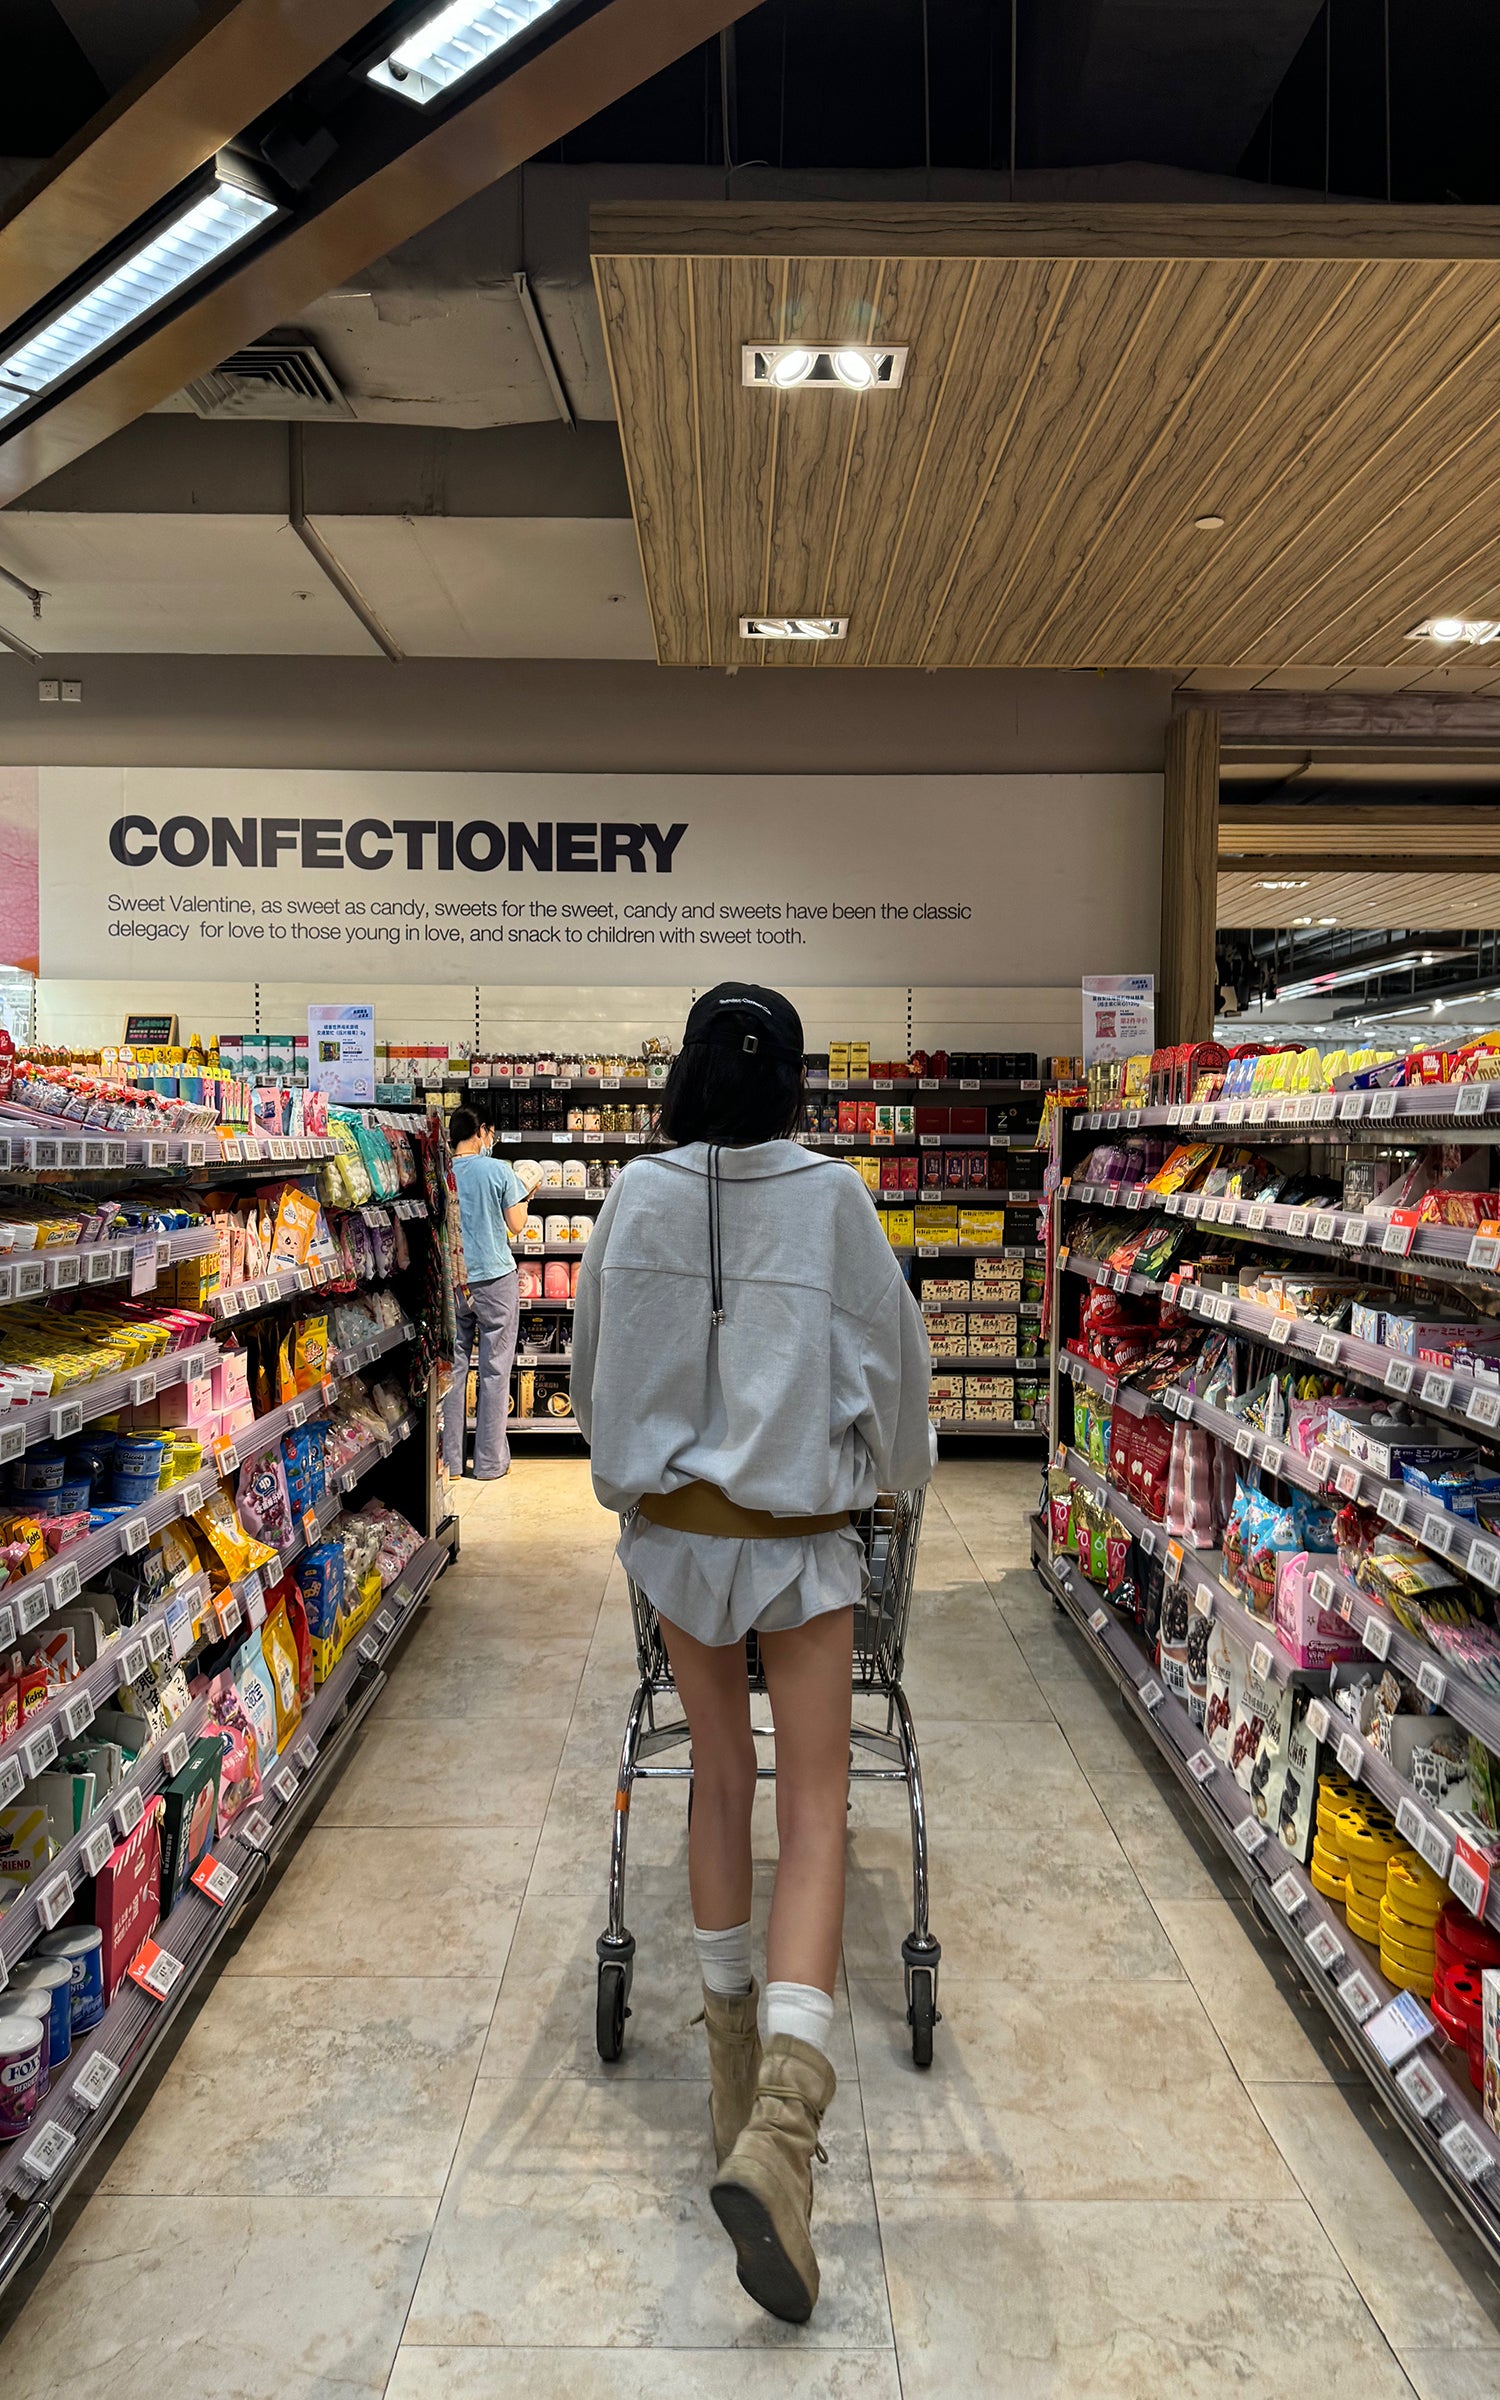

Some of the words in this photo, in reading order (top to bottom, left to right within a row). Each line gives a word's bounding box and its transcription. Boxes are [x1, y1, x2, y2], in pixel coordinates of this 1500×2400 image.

[109, 815, 688, 873] CONFECTIONERY
[108, 894, 165, 911] Sweet
[170, 895, 255, 915] Valentine,
[261, 901, 282, 913] as
[287, 899, 340, 914] sweet
[345, 902, 366, 915] as
[370, 899, 429, 919] candy,
[435, 901, 497, 917] sweets
[501, 900, 525, 917] for
[529, 901, 557, 917] the
[561, 902, 618, 920] sweet,
[624, 902, 677, 922] candy
[682, 902, 714, 919] and
[720, 904, 781, 919] sweets
[786, 903, 827, 919] have
[833, 903, 875, 919] been
[881, 903, 908, 919] the
[913, 903, 971, 919] classic
[108, 920, 189, 941] delegacy
[200, 921, 224, 937] for
[229, 921, 264, 938] love
[268, 923, 286, 939] to
[291, 922, 341, 940] those
[345, 927, 400, 944] young
[406, 924, 419, 940] in
[425, 924, 464, 943] love,
[470, 925, 503, 942] and
[508, 926, 561, 942] snack
[565, 927, 582, 942] to
[587, 926, 654, 943] children
[659, 927, 695, 943] with
[700, 928, 752, 944] sweet
[756, 928, 805, 944] tooth.
[1478, 1061, 1500, 1081] mei
[1348, 1166, 1369, 1186] meiji
[1054, 1504, 1068, 1520] 70
[1076, 1529, 1089, 1546] 70
[1110, 1541, 1127, 1559] 70
[70, 1984, 85, 1993] NTS
